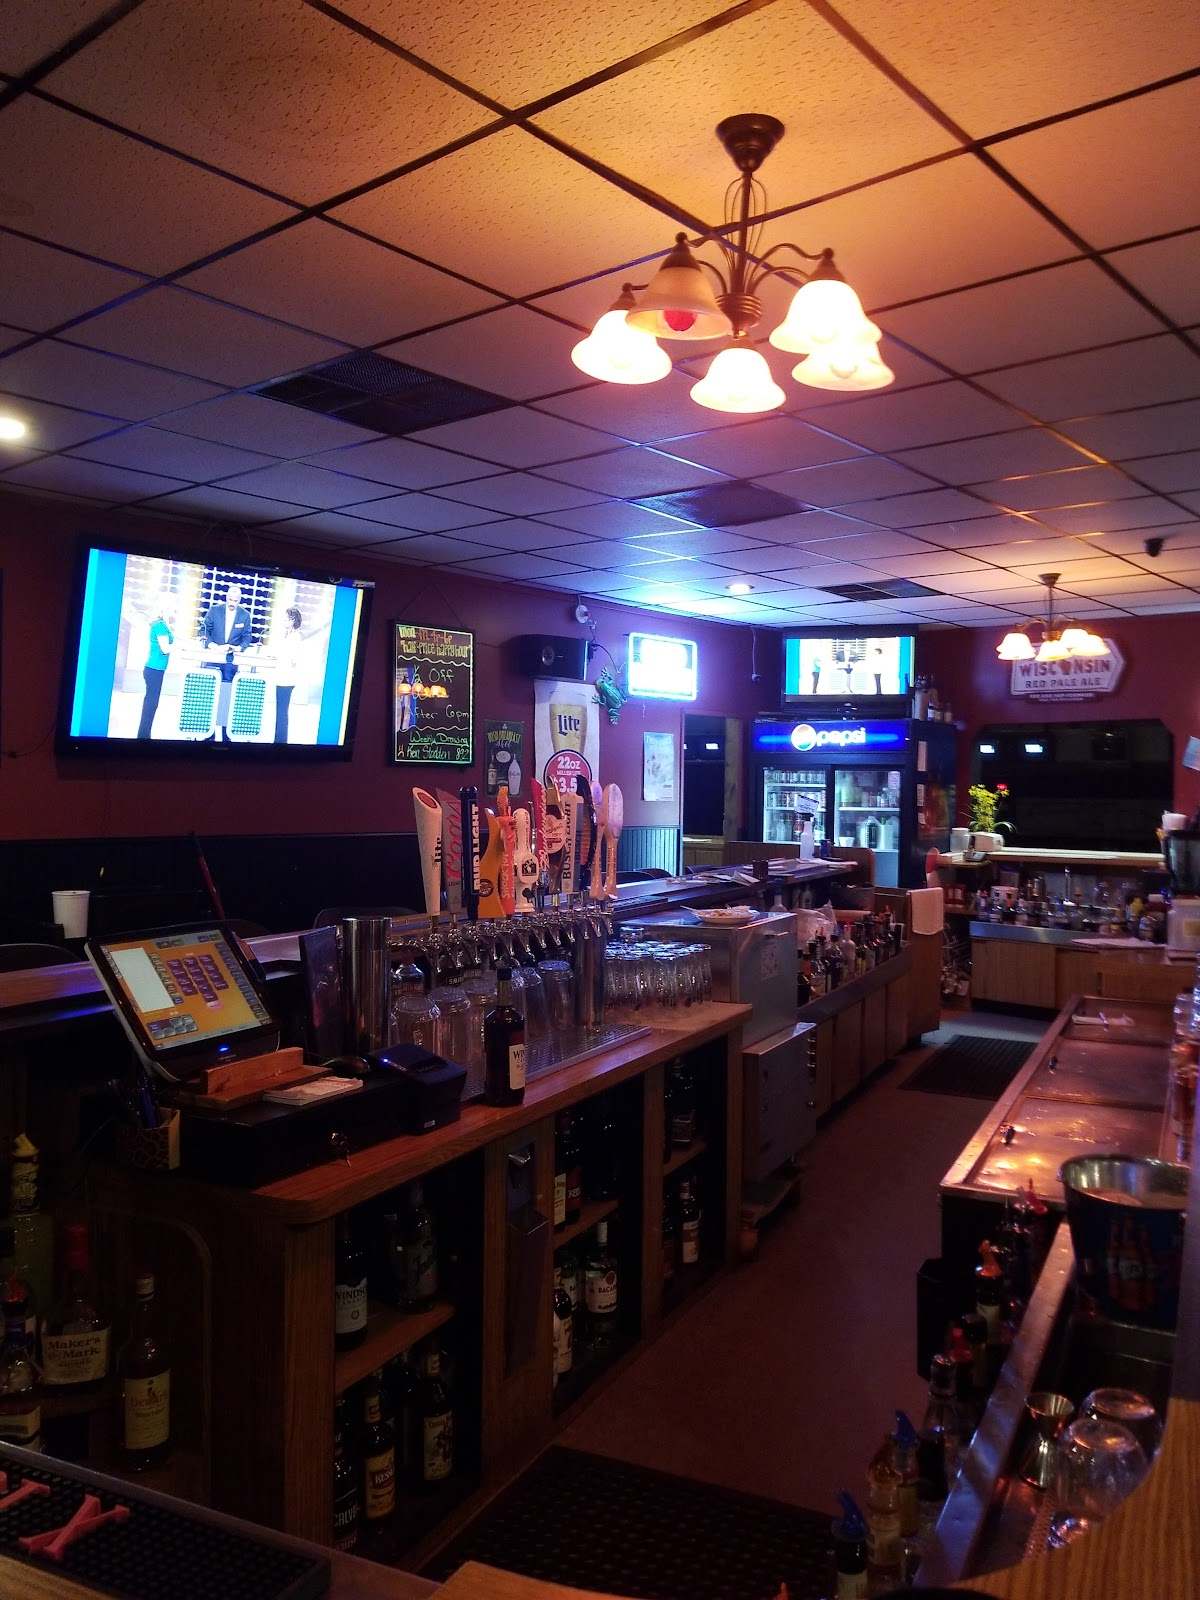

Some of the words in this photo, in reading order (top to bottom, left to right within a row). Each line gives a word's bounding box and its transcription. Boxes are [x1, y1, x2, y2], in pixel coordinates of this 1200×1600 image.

[557, 714, 581, 737] Lite
[816, 727, 867, 747] pepsi
[471, 803, 480, 852] LIGHT
